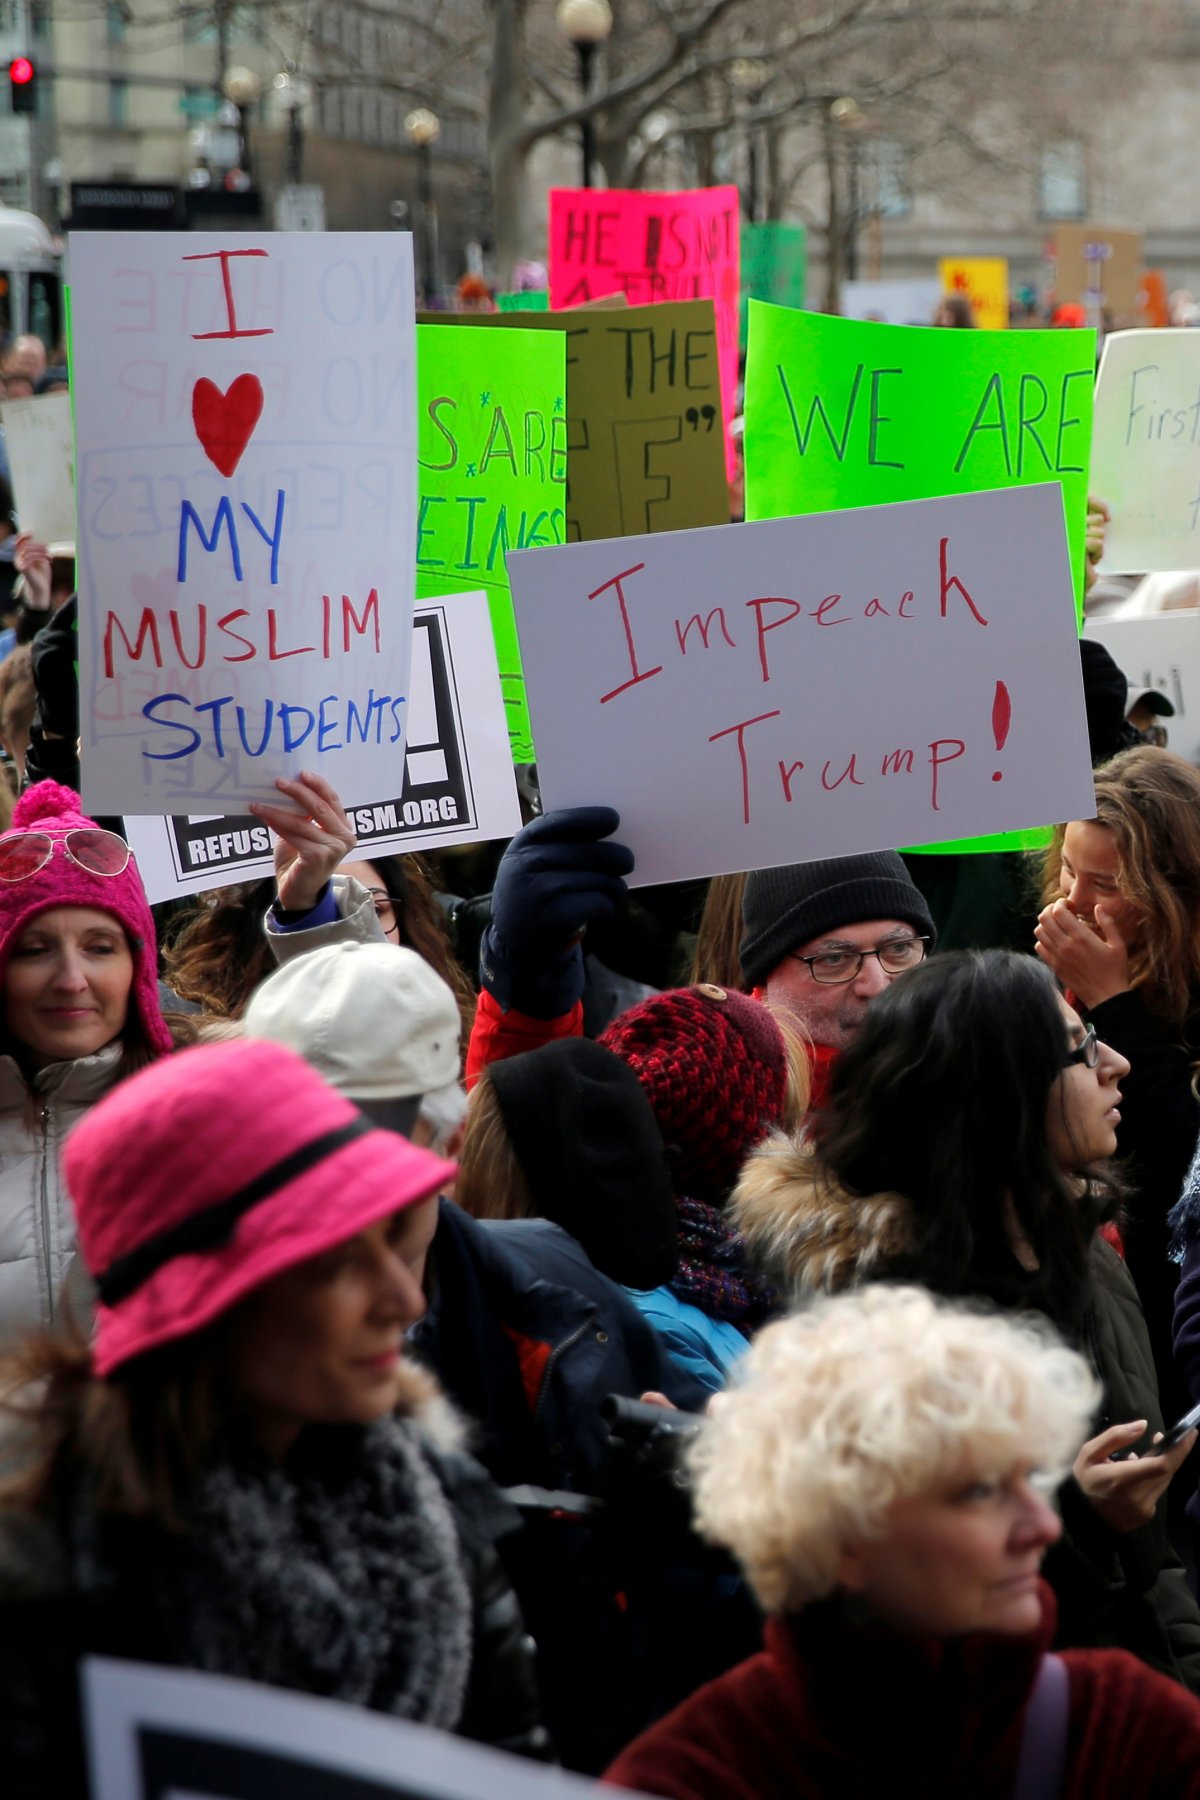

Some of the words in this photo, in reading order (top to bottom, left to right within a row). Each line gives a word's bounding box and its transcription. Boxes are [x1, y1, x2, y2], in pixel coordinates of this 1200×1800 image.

[565, 210, 621, 267] HE
[182, 248, 275, 340] I
[606, 327, 714, 398] THE
[479, 406, 567, 483] ARE
[777, 364, 905, 469] WE
[953, 370, 1094, 477] ARE
[176, 489, 286, 584] MY
[103, 588, 381, 679] MUSLIM
[588, 536, 988, 704] Impeach
[141, 689, 406, 760] STUDENTS
[708, 680, 1012, 824] Trump!
